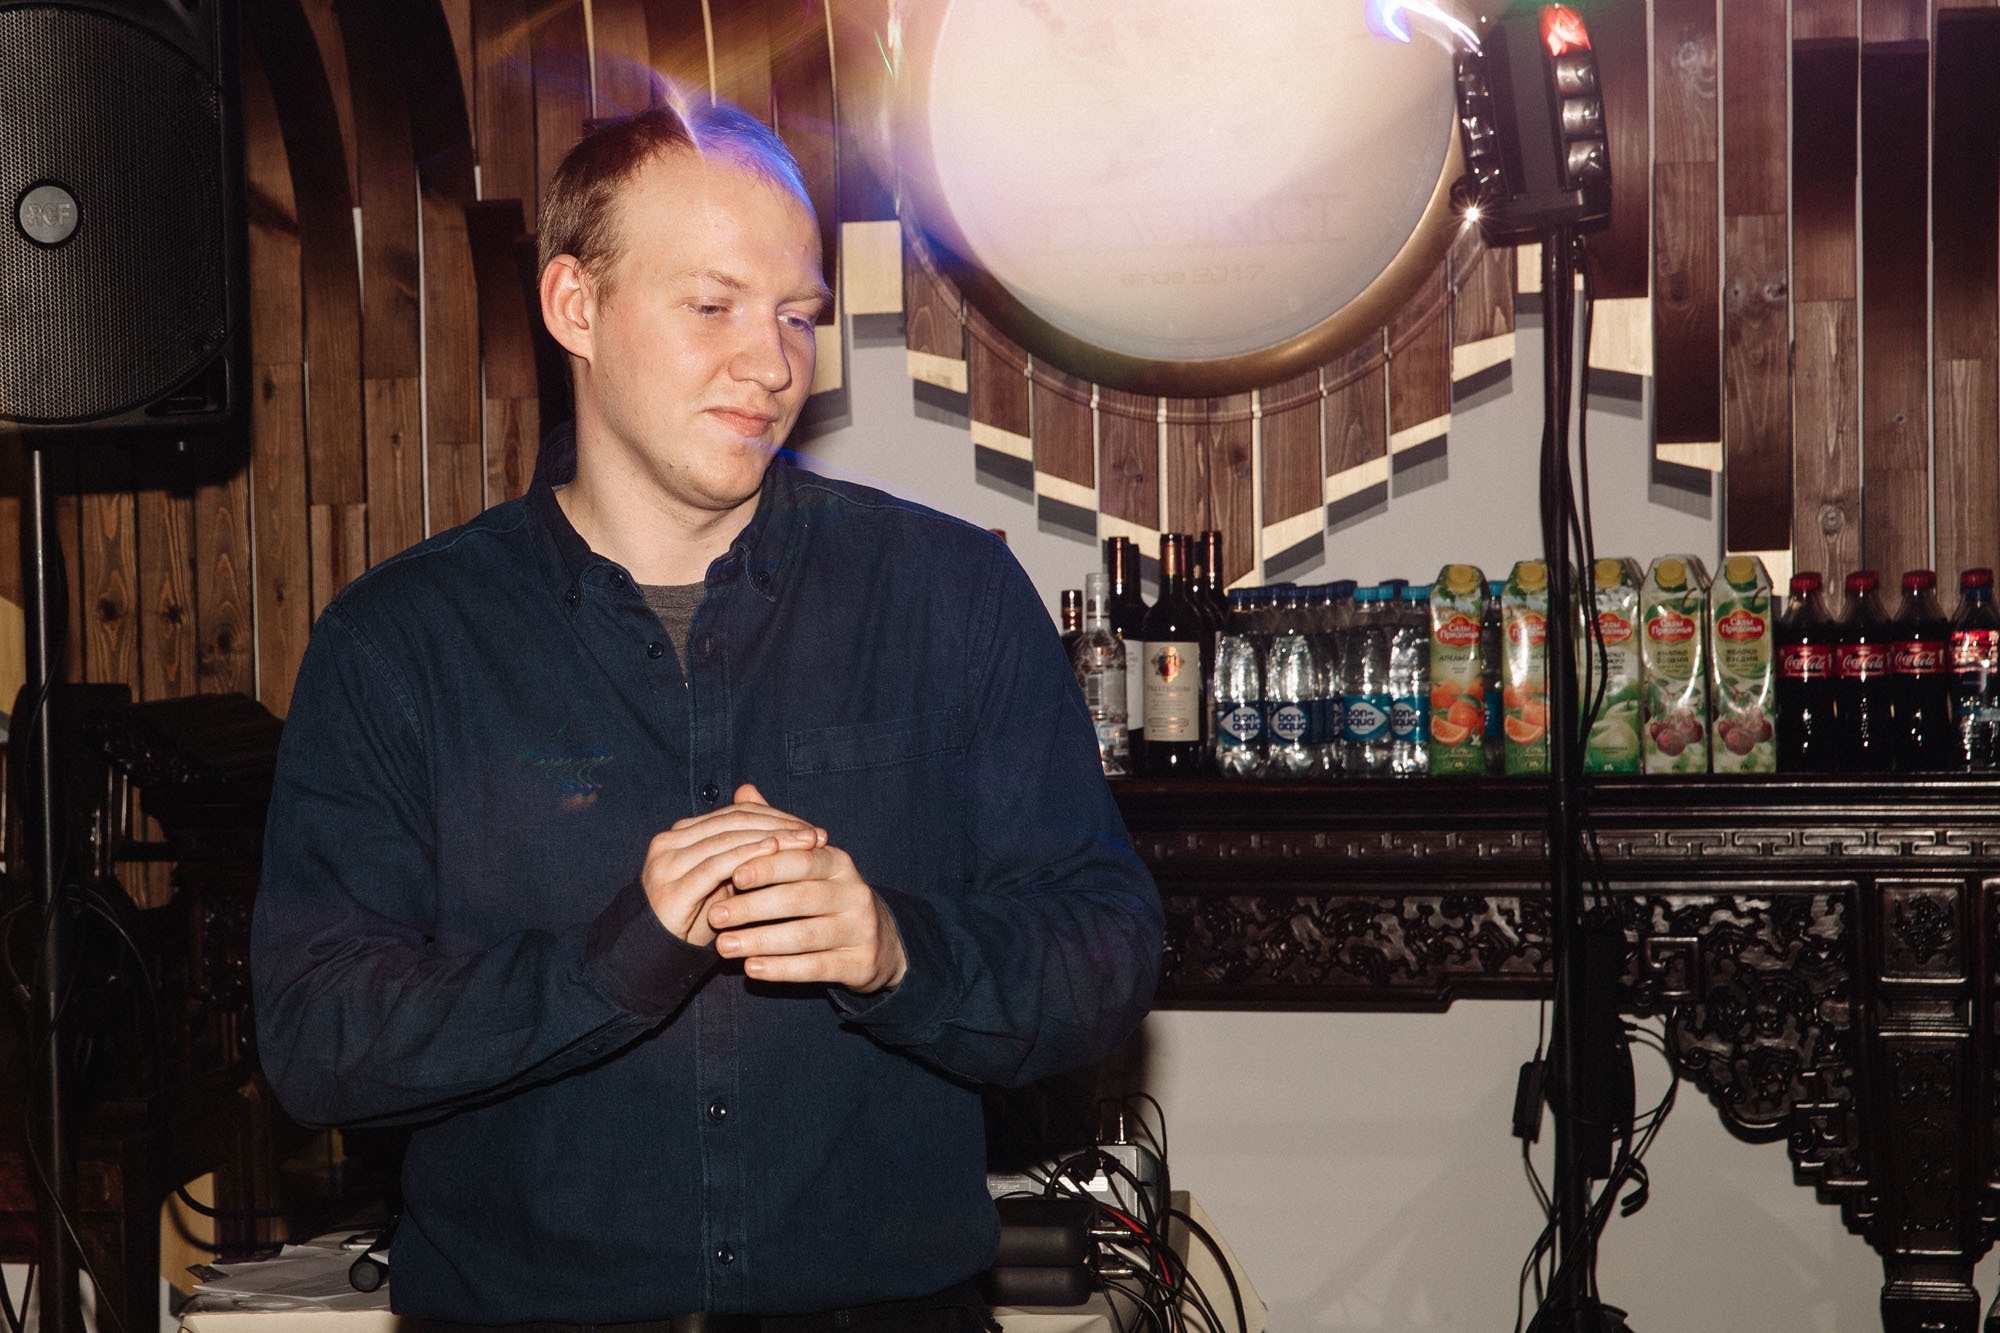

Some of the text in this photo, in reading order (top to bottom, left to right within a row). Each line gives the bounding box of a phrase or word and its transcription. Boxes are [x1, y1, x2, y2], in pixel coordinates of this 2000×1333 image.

[26, 202, 71, 226] RCF
[1191, 264, 1266, 285] 2017
[1278, 722, 1307, 733] aqua
